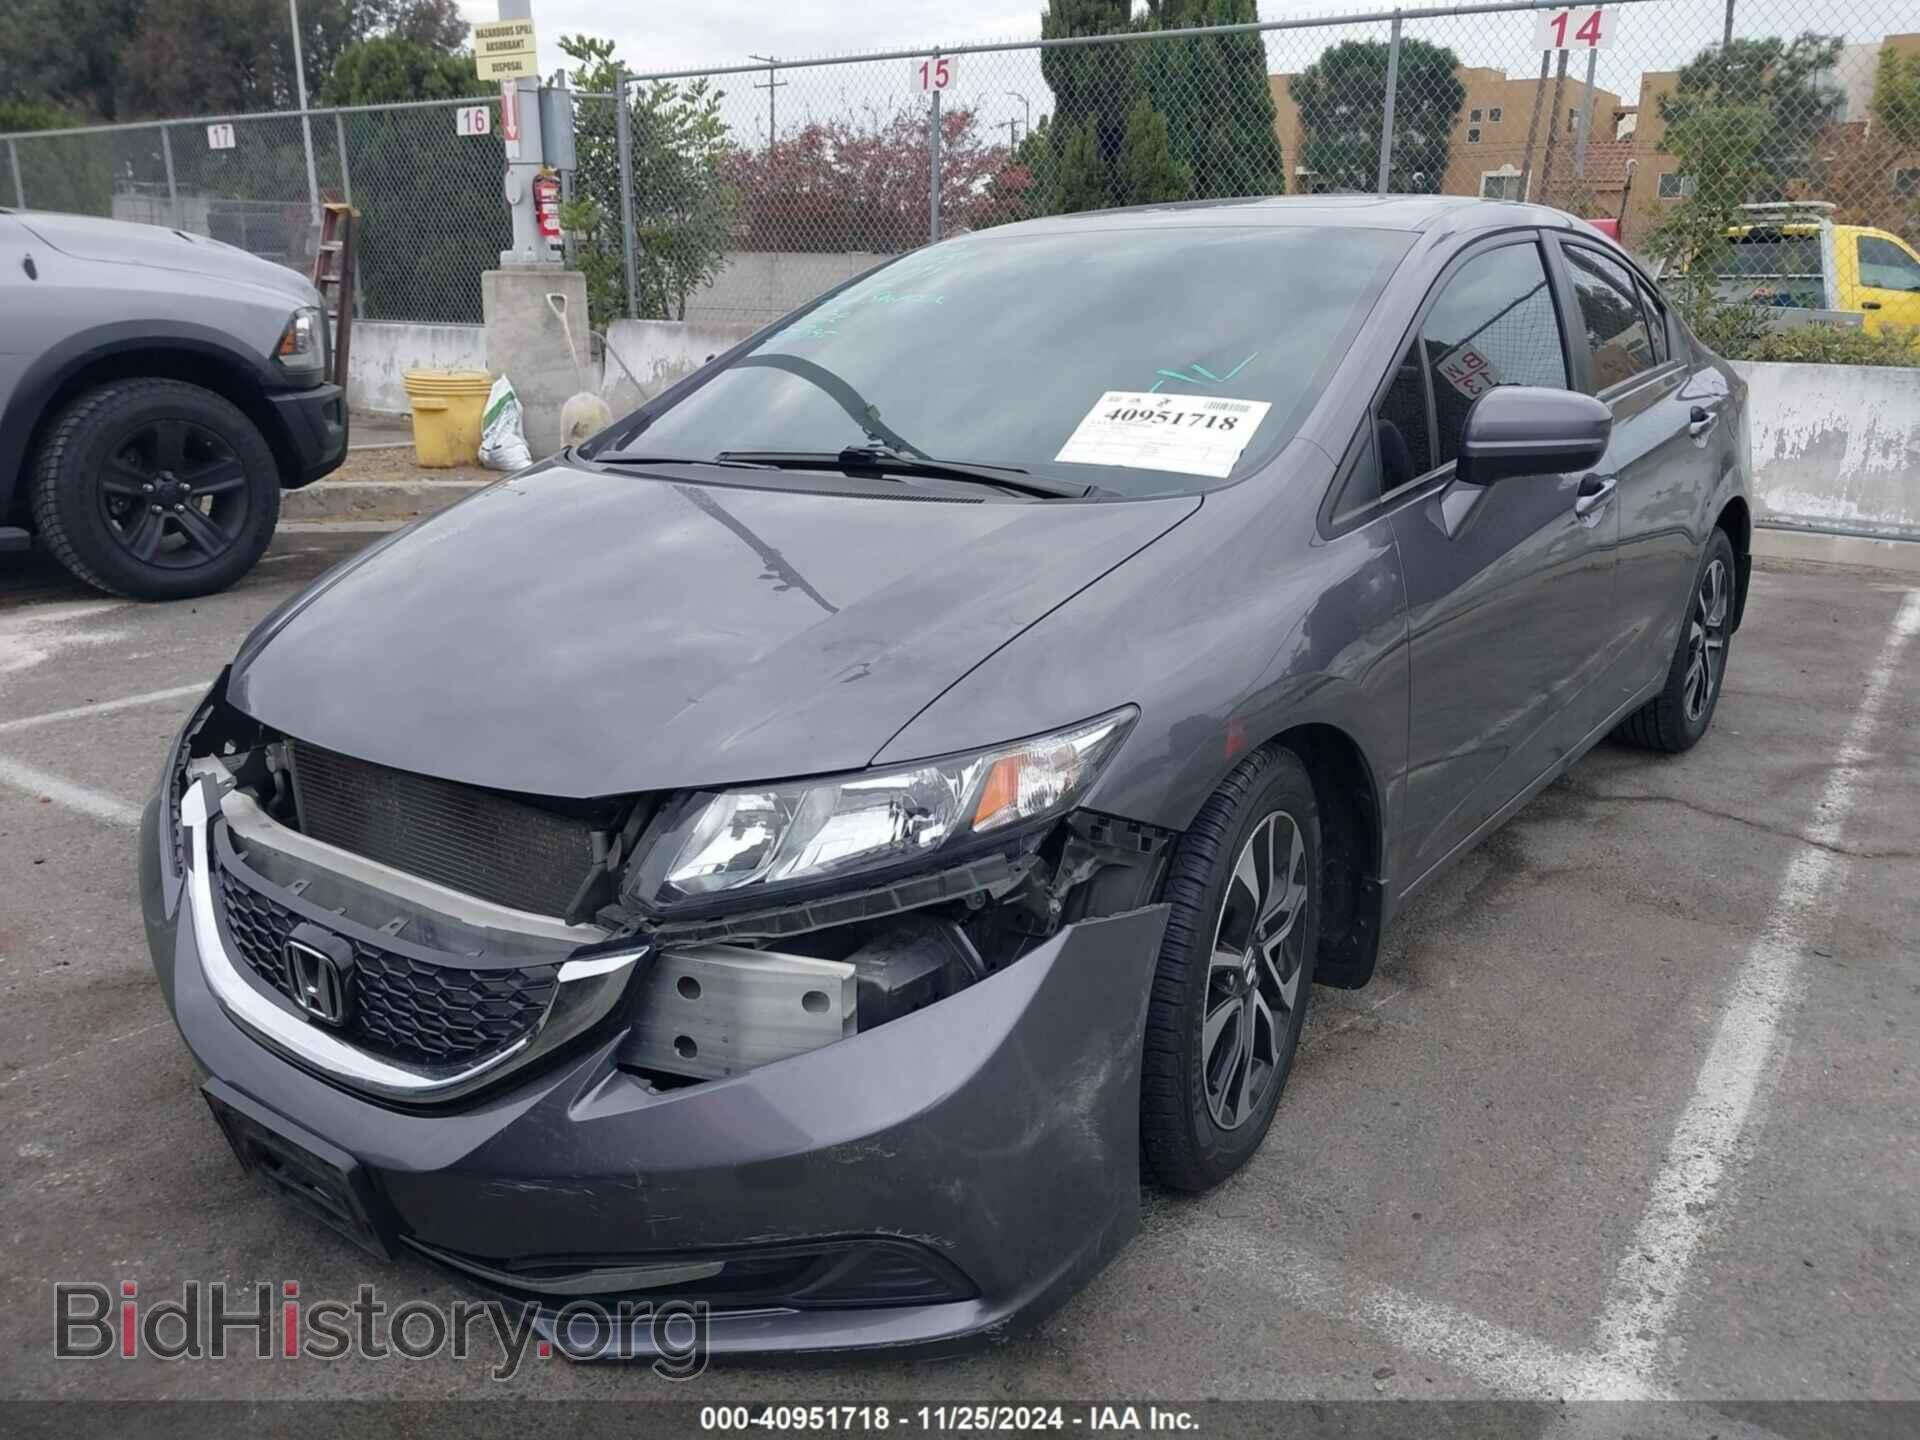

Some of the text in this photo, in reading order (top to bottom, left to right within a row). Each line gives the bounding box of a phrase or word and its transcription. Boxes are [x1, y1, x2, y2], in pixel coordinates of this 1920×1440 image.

[1551, 10, 1602, 48] 14
[919, 60, 949, 90] 15
[464, 109, 484, 133] 16
[214, 126, 229, 147] 17
[1104, 407, 1239, 431] 40951718
